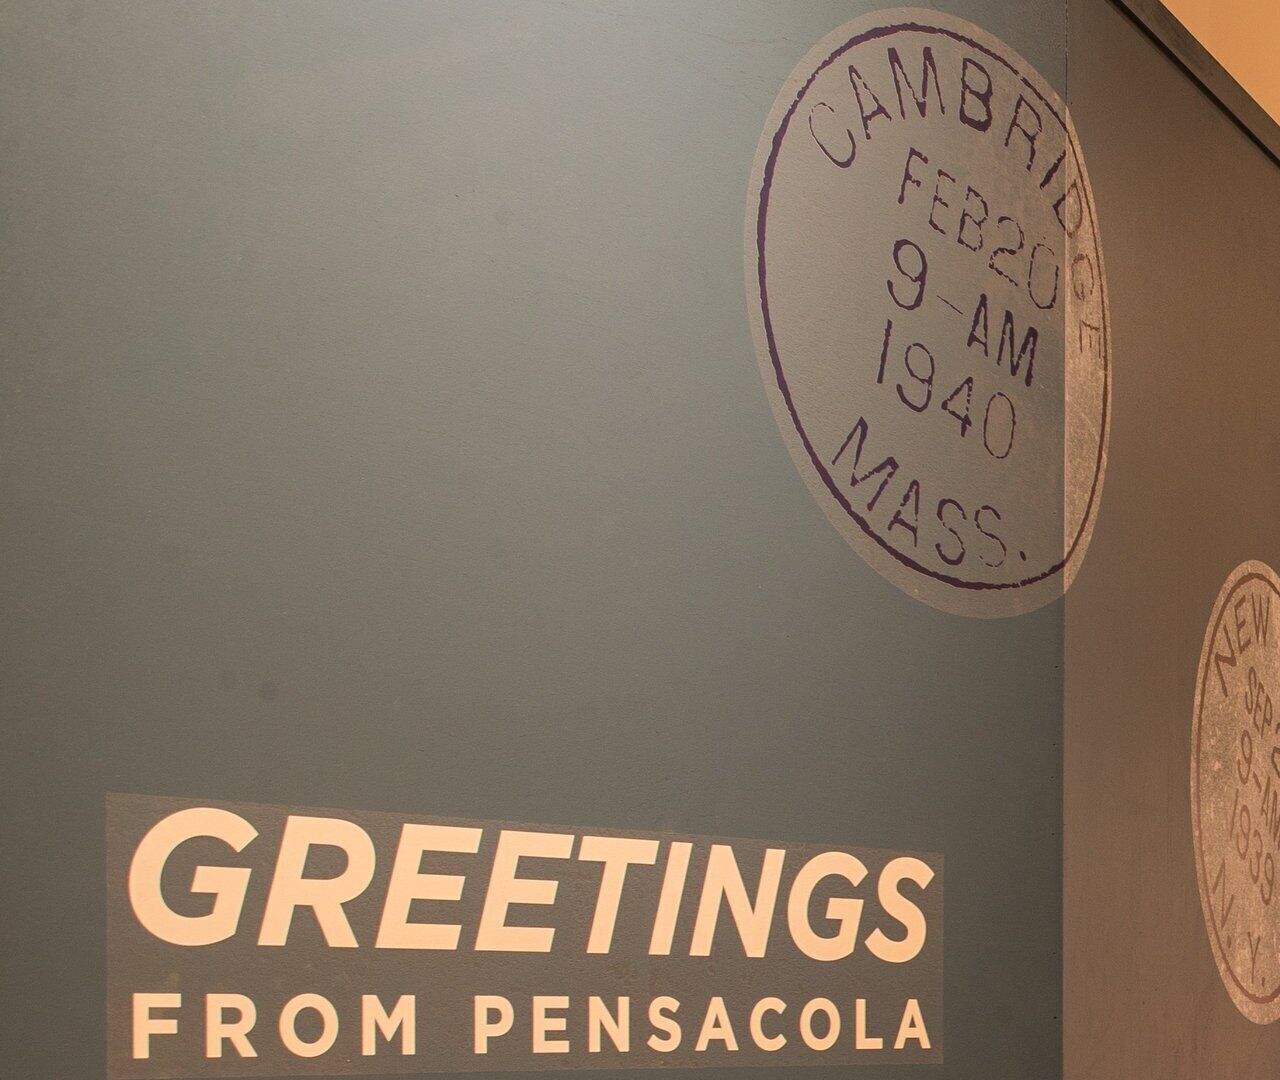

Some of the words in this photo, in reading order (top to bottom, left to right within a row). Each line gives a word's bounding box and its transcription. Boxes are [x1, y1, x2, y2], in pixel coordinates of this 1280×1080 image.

[808, 46, 1101, 354] CAMBRIDGE
[877, 319, 1017, 459] 1940
[832, 416, 1027, 568] MASS.
[1213, 594, 1270, 698] NEW
[127, 806, 935, 964] GREETINGS
[131, 992, 417, 1060] FROM
[473, 994, 932, 1055] PENSACOLA
